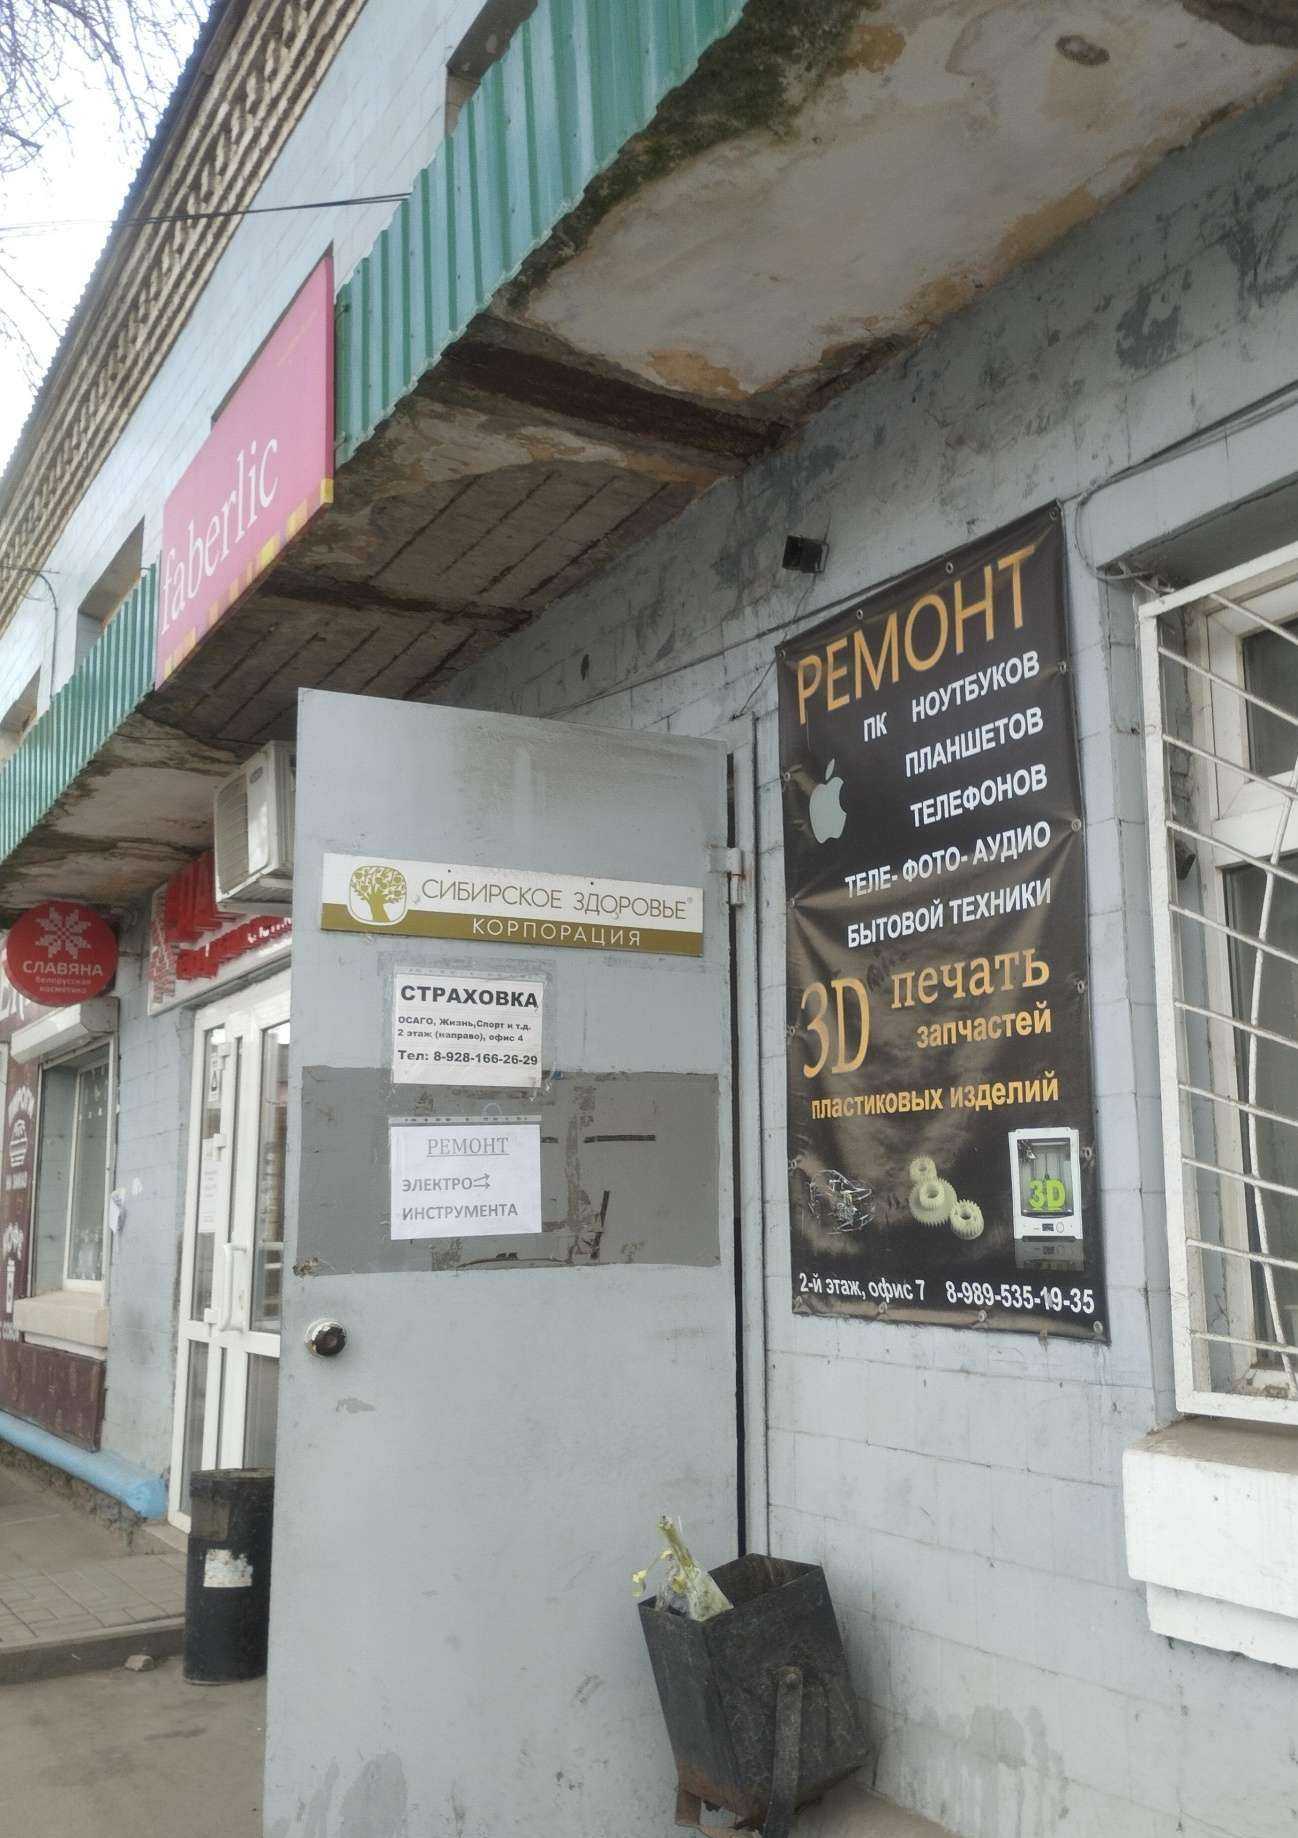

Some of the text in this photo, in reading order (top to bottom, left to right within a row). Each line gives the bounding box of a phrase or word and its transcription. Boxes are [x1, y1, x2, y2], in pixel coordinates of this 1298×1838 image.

[161, 438, 279, 635] faberlic
[797, 544, 1035, 725] РЕМОНТ
[863, 650, 1040, 742] ПК НОУТБУКОВ
[905, 707, 1044, 778] ПЛАНШЕТОВ
[910, 763, 1048, 828] ТЕЛЕФОНОВ
[845, 821, 1051, 898] ТЕЛЕ- ФОТО- АУДИО
[421, 878, 687, 920] СИБИРСКОЕ ЗДОРОВЬЕ
[847, 878, 1051, 948] БЫТОВОЙ ТЕХНИКИ
[472, 918, 641, 947] КОРПОРАЦИЯ
[22, 960, 104, 977] СЛАВЯНА
[400, 985, 539, 1008] СТРАХОВКА
[801, 948, 1050, 1078] 3D печать
[398, 1016, 436, 1026] ОСАГО,
[406, 1030, 432, 1038] этаж
[489, 1033, 515, 1042] офис
[517, 1034, 524, 1042] 4
[916, 1001, 1052, 1048] запчастей
[398, 1050, 538, 1066] Тел: 8-928-166-26-29
[811, 1070, 1059, 1120] пластиковых изделий
[427, 1137, 510, 1156] РЕМОНТ
[402, 1177, 473, 1192] ЭЛЕКТРО
[1028, 1178, 1067, 1212] 3D
[402, 1203, 519, 1221] ИНСТРУМЕНТА
[799, 1273, 1096, 1314] 2-й этаж, офис 7 8-989-535-19-35
